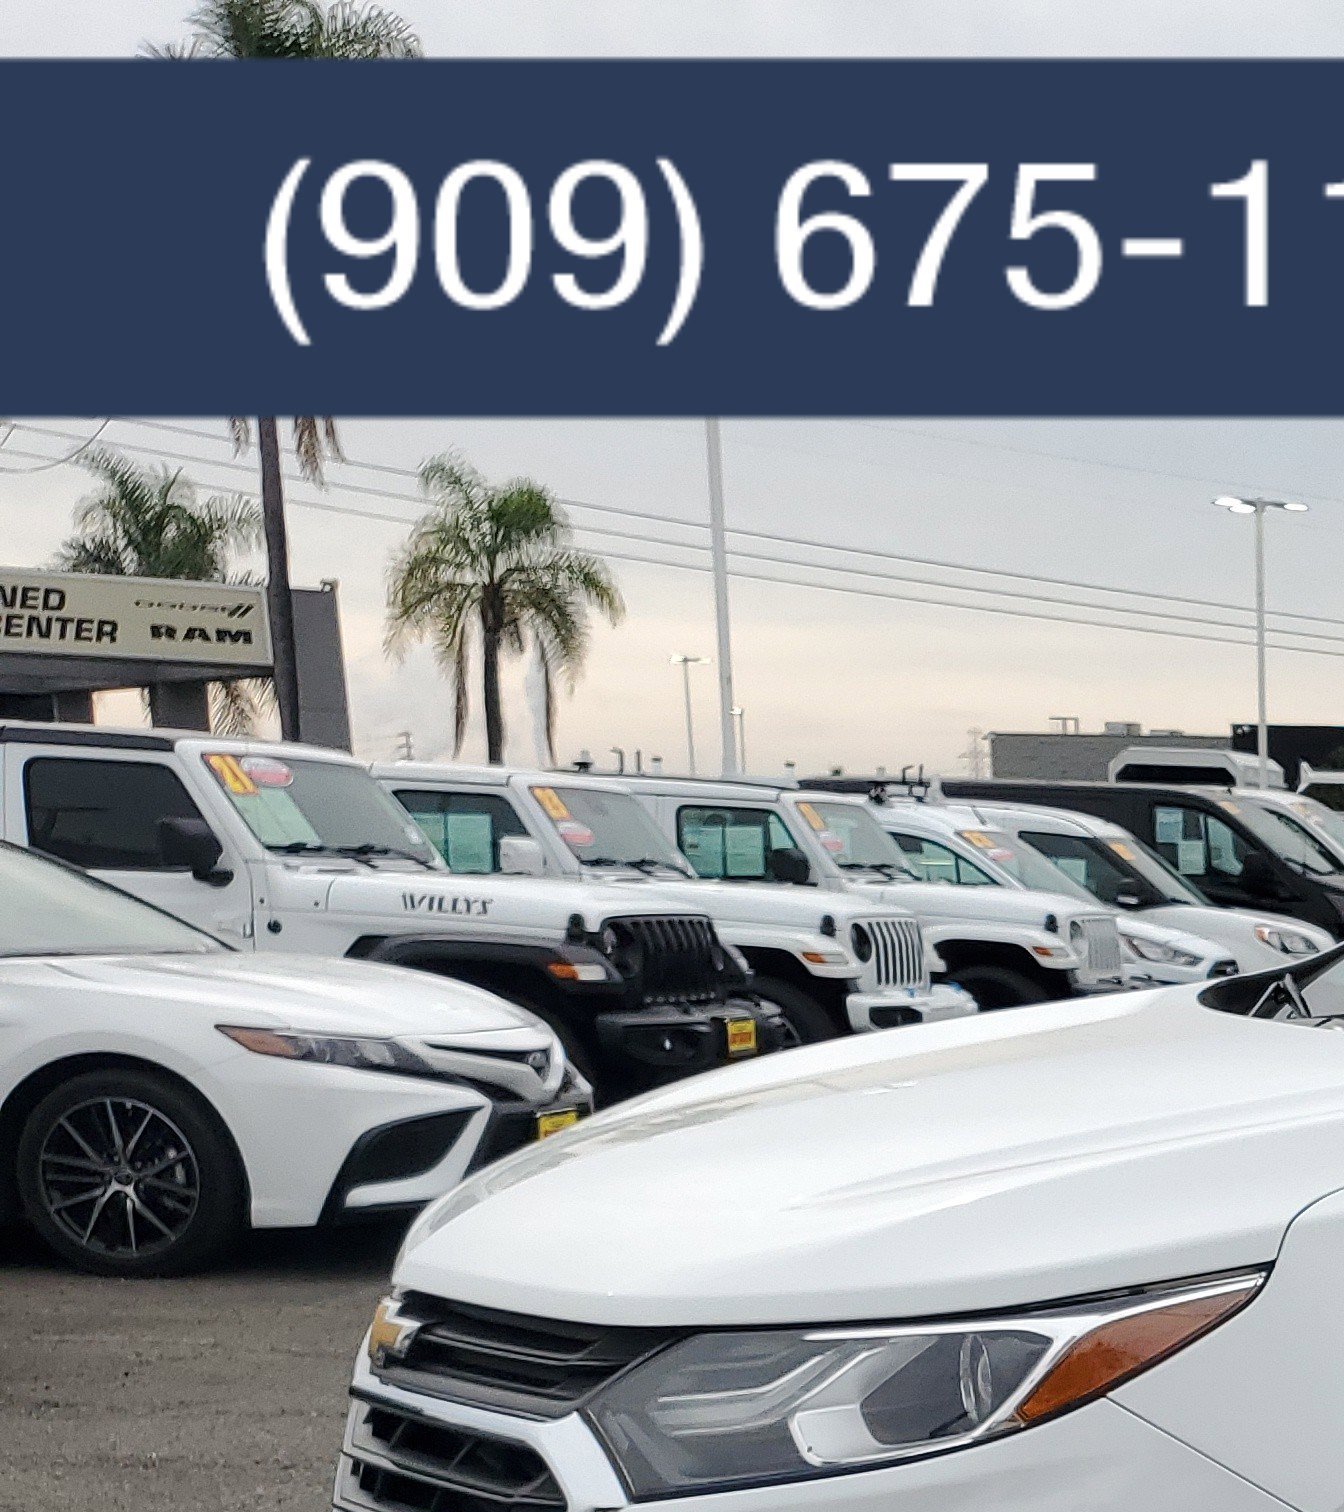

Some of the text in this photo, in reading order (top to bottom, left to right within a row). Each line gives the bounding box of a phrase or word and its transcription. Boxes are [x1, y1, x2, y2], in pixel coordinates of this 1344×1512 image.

[0, 613, 119, 644] ENTER
[150, 622, 253, 645] RAM
[401, 891, 496, 916] WILLYS
